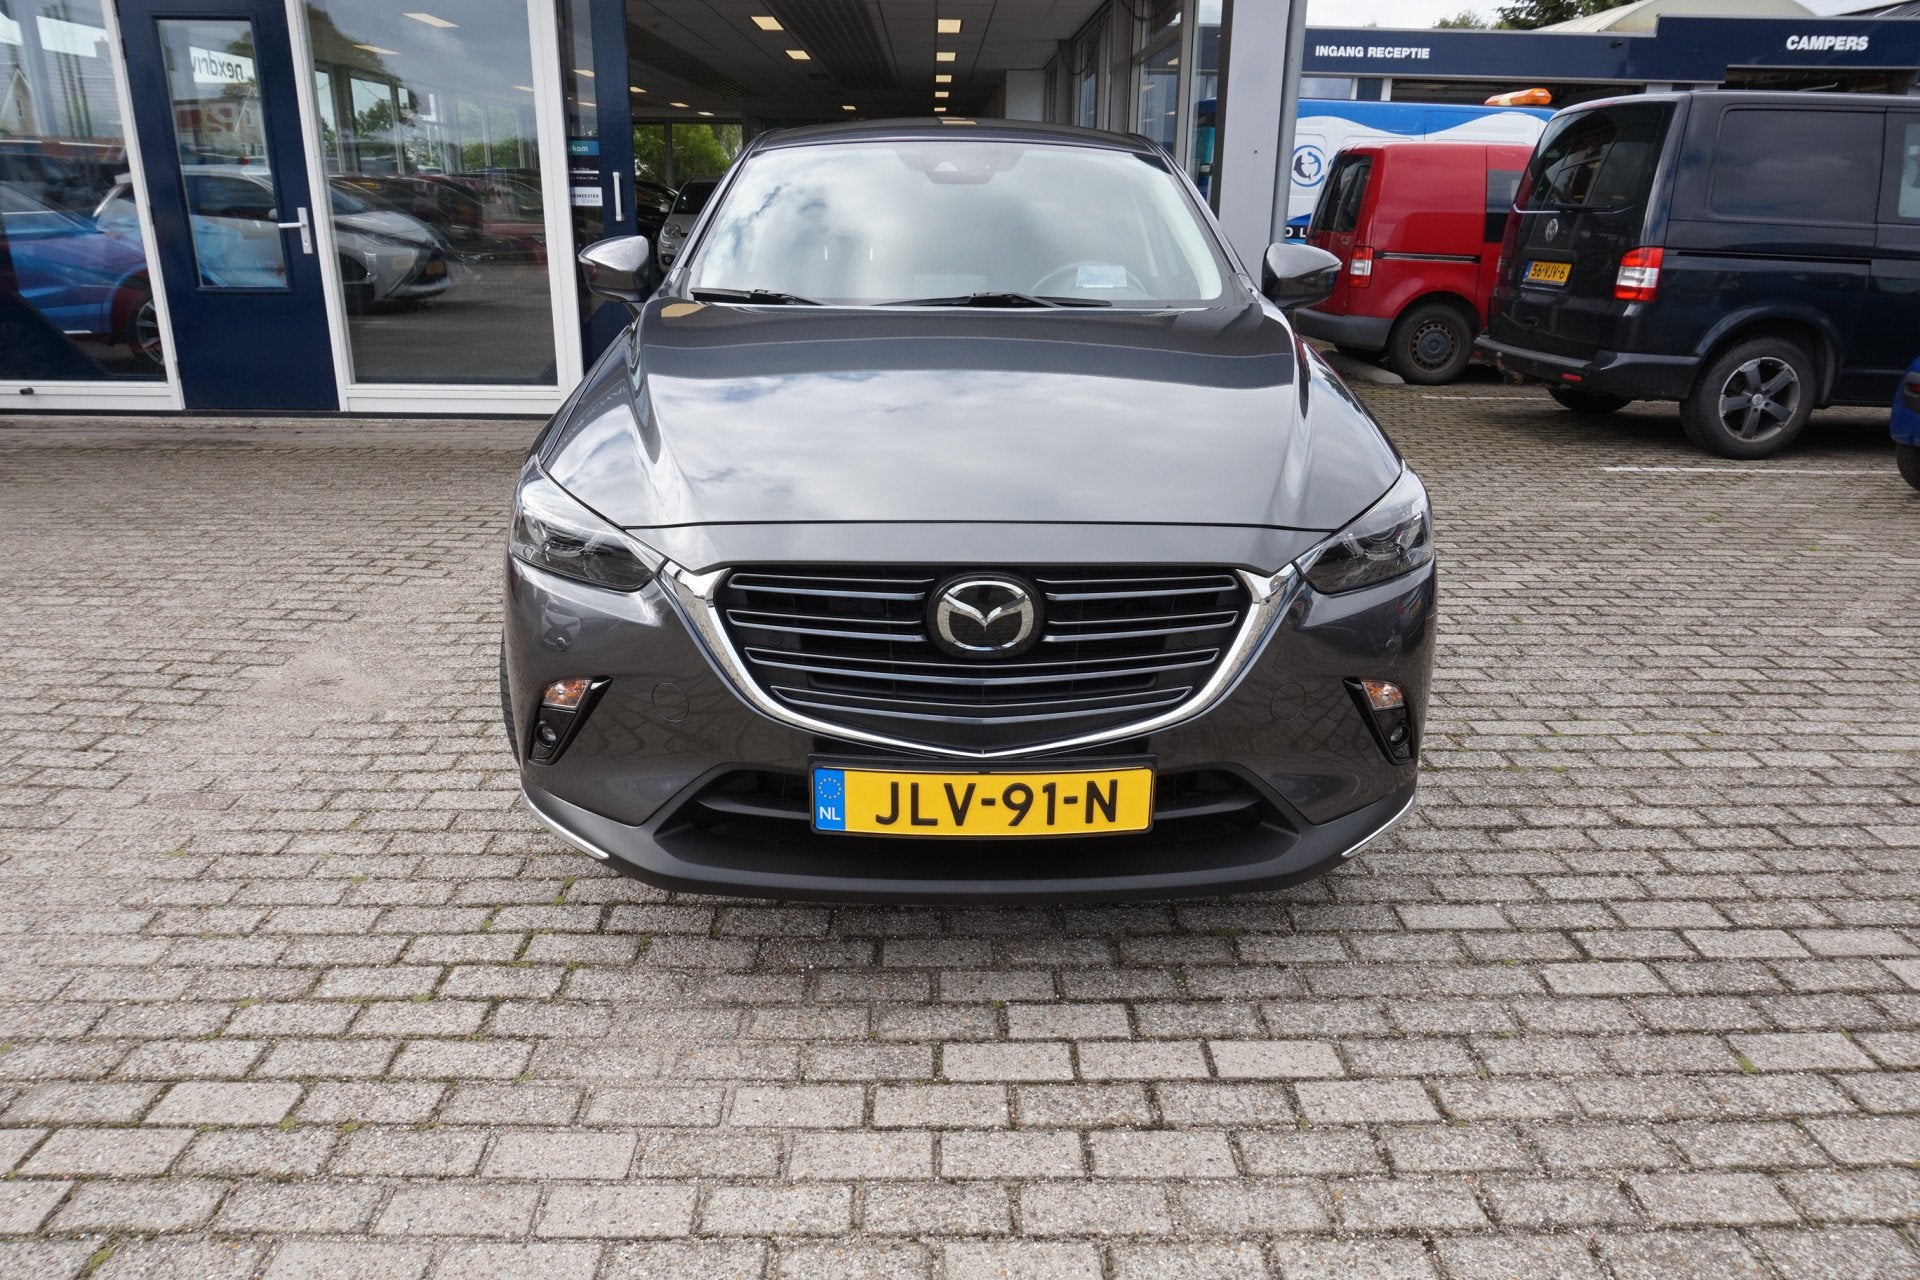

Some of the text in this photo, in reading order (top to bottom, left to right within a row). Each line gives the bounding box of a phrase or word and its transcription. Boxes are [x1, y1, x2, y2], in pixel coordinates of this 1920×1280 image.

[1786, 35, 1869, 51] CAMPERS
[1315, 45, 1430, 59] INGANG RECEPTIE
[875, 779, 1118, 827] JLV-91-N
[819, 807, 841, 820] NL
